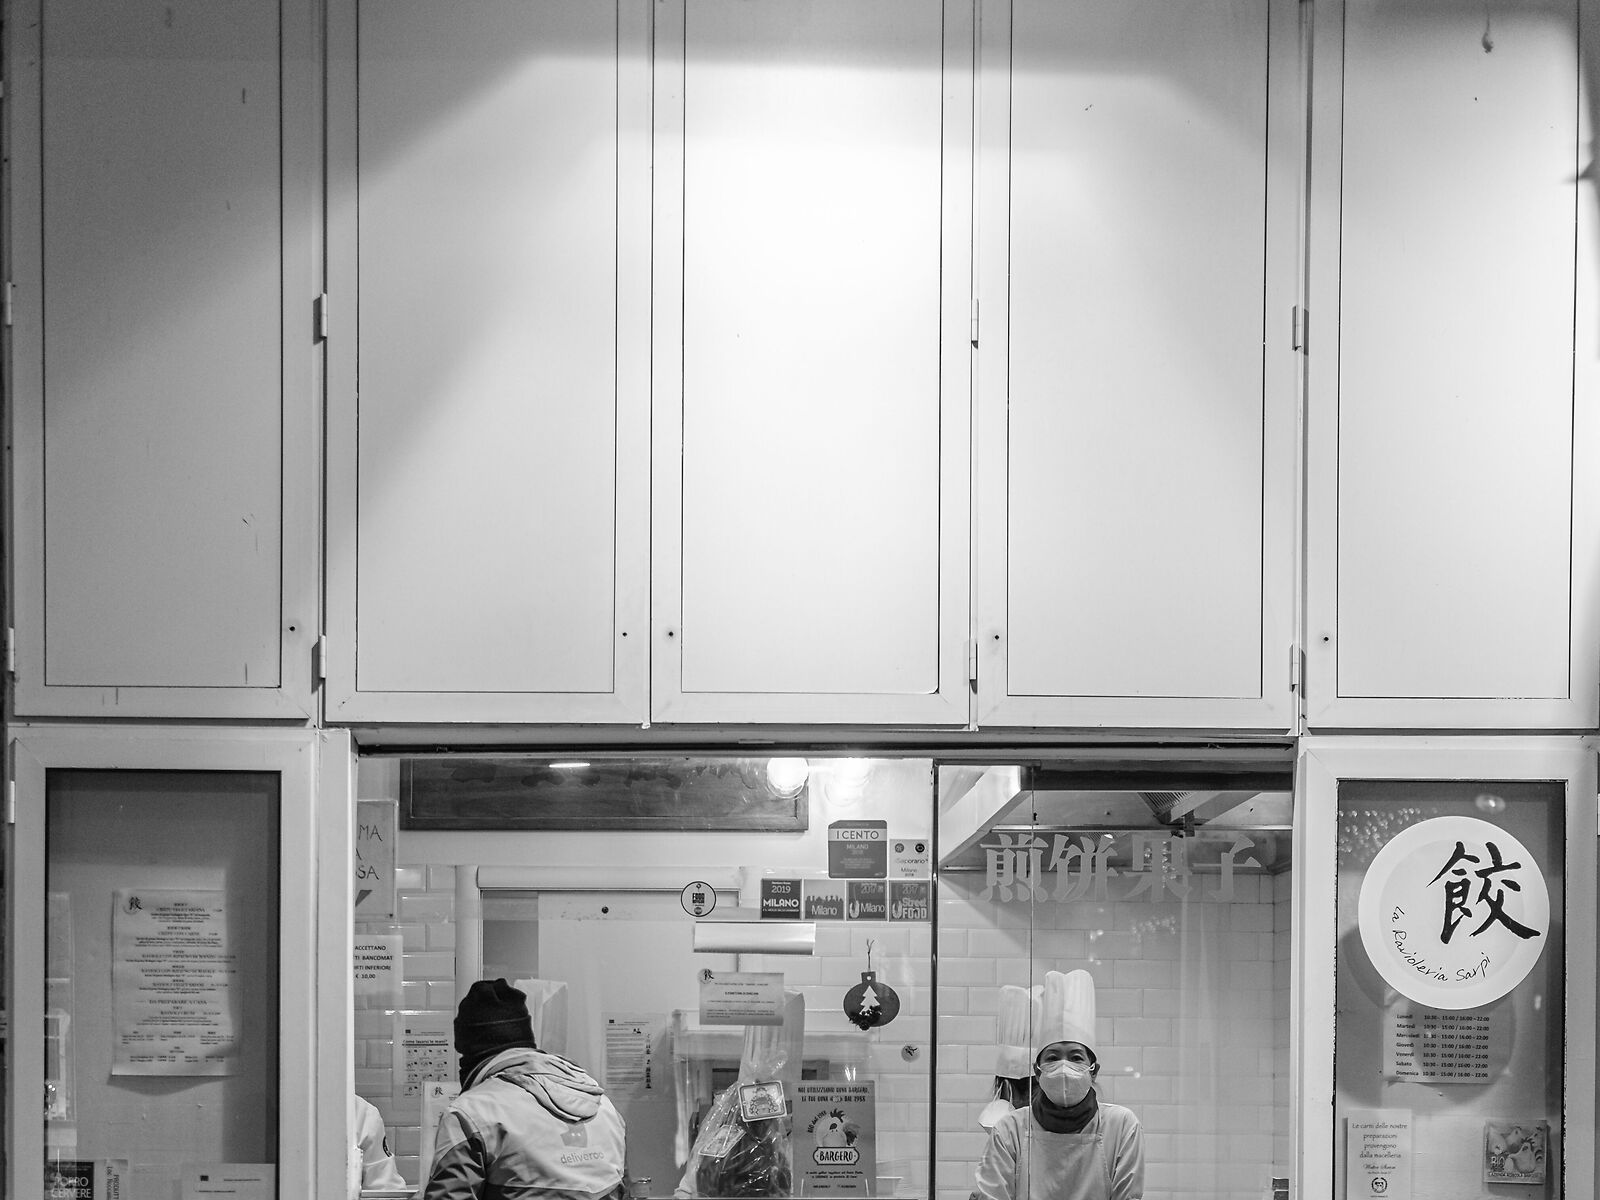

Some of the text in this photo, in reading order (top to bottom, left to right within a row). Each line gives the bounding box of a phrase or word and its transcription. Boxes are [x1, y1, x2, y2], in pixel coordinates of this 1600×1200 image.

[836, 830, 879, 840] I CENTO
[771, 885, 791, 894] 2019
[1426, 841, 1541, 944] 餃
[763, 898, 799, 908] MILANO
[860, 902, 885, 912] Milano
[811, 904, 838, 916] Milano
[902, 908, 927, 918] FOOD
[1392, 930, 1448, 982] Ravioleria
[1456, 952, 1490, 982] Sarpi
[560, 1152, 604, 1164] deliveroo
[819, 1151, 853, 1162] BARGERO
